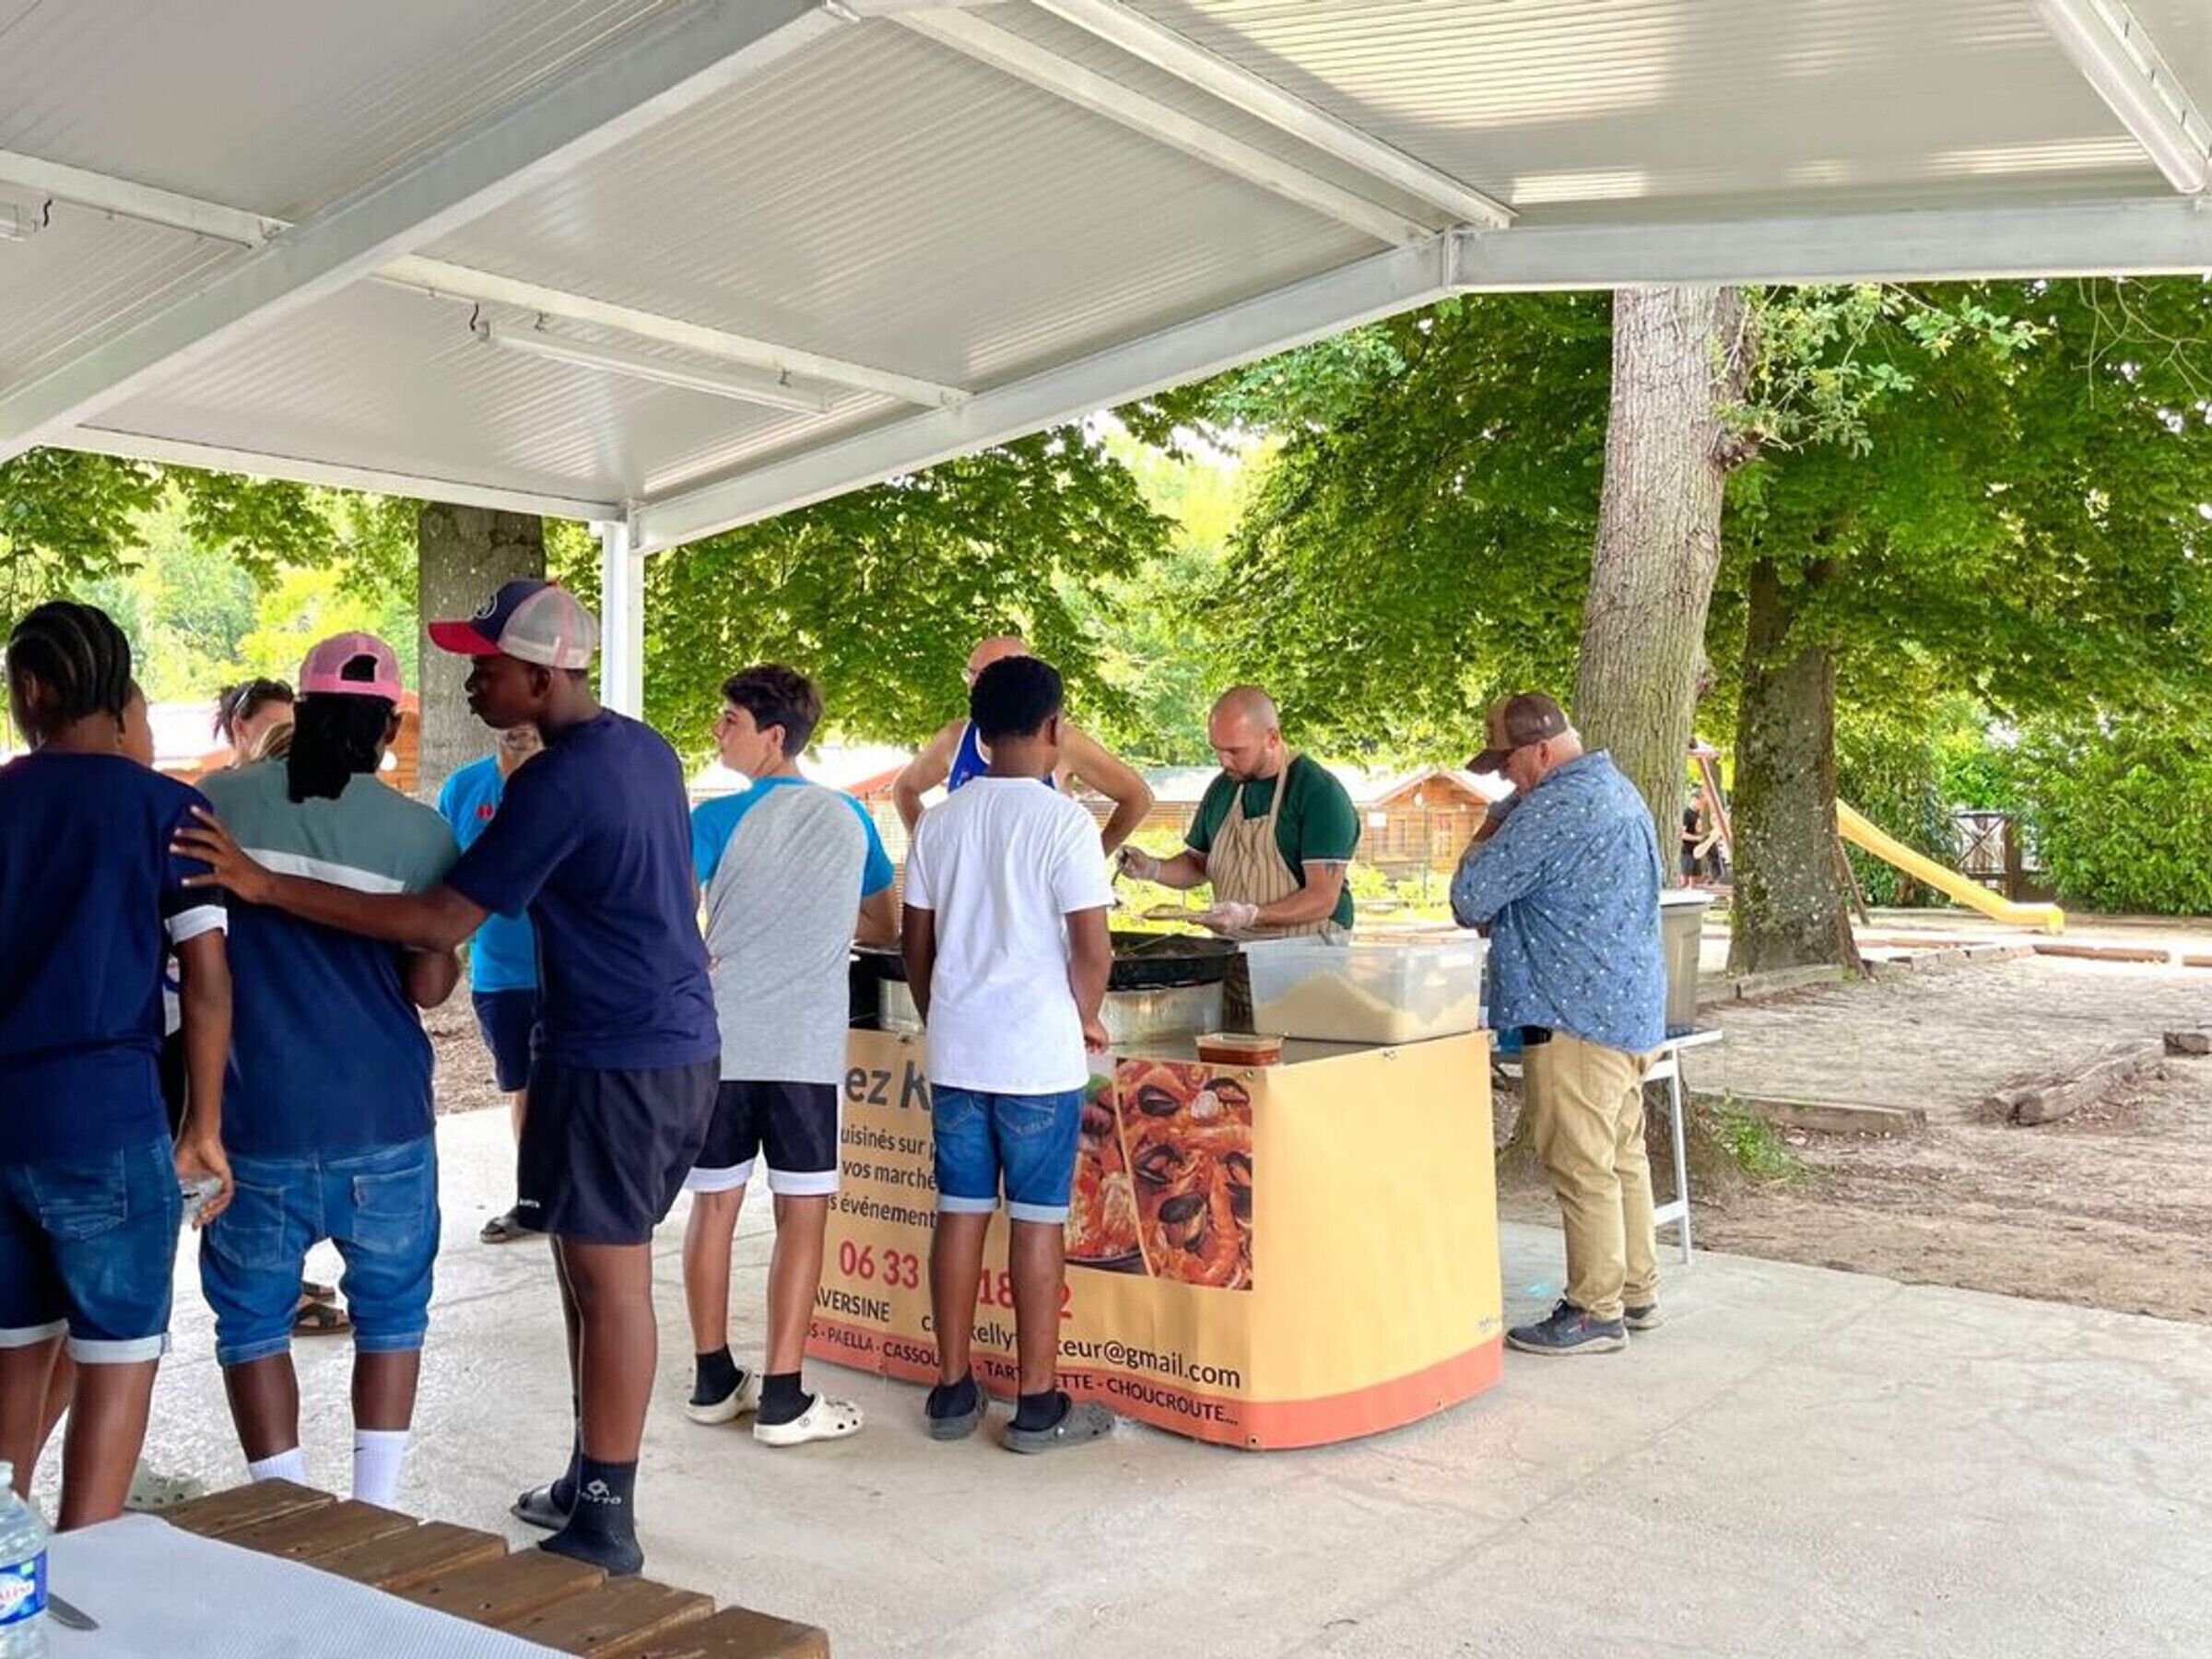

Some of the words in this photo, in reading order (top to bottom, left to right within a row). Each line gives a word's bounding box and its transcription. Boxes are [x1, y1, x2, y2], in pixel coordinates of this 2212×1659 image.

[845, 1066, 891, 1106] ez
[841, 1124, 896, 1151] uisinés
[899, 1137, 925, 1156] sur
[842, 1160, 872, 1179] vos
[841, 1192, 937, 1229] événement
[840, 1241, 875, 1280] 06
[883, 1249, 919, 1289] 33
[979, 1268, 1014, 1309] 18
[828, 1326, 874, 1353] PAELLA
[882, 1341, 941, 1367] CASSOU
